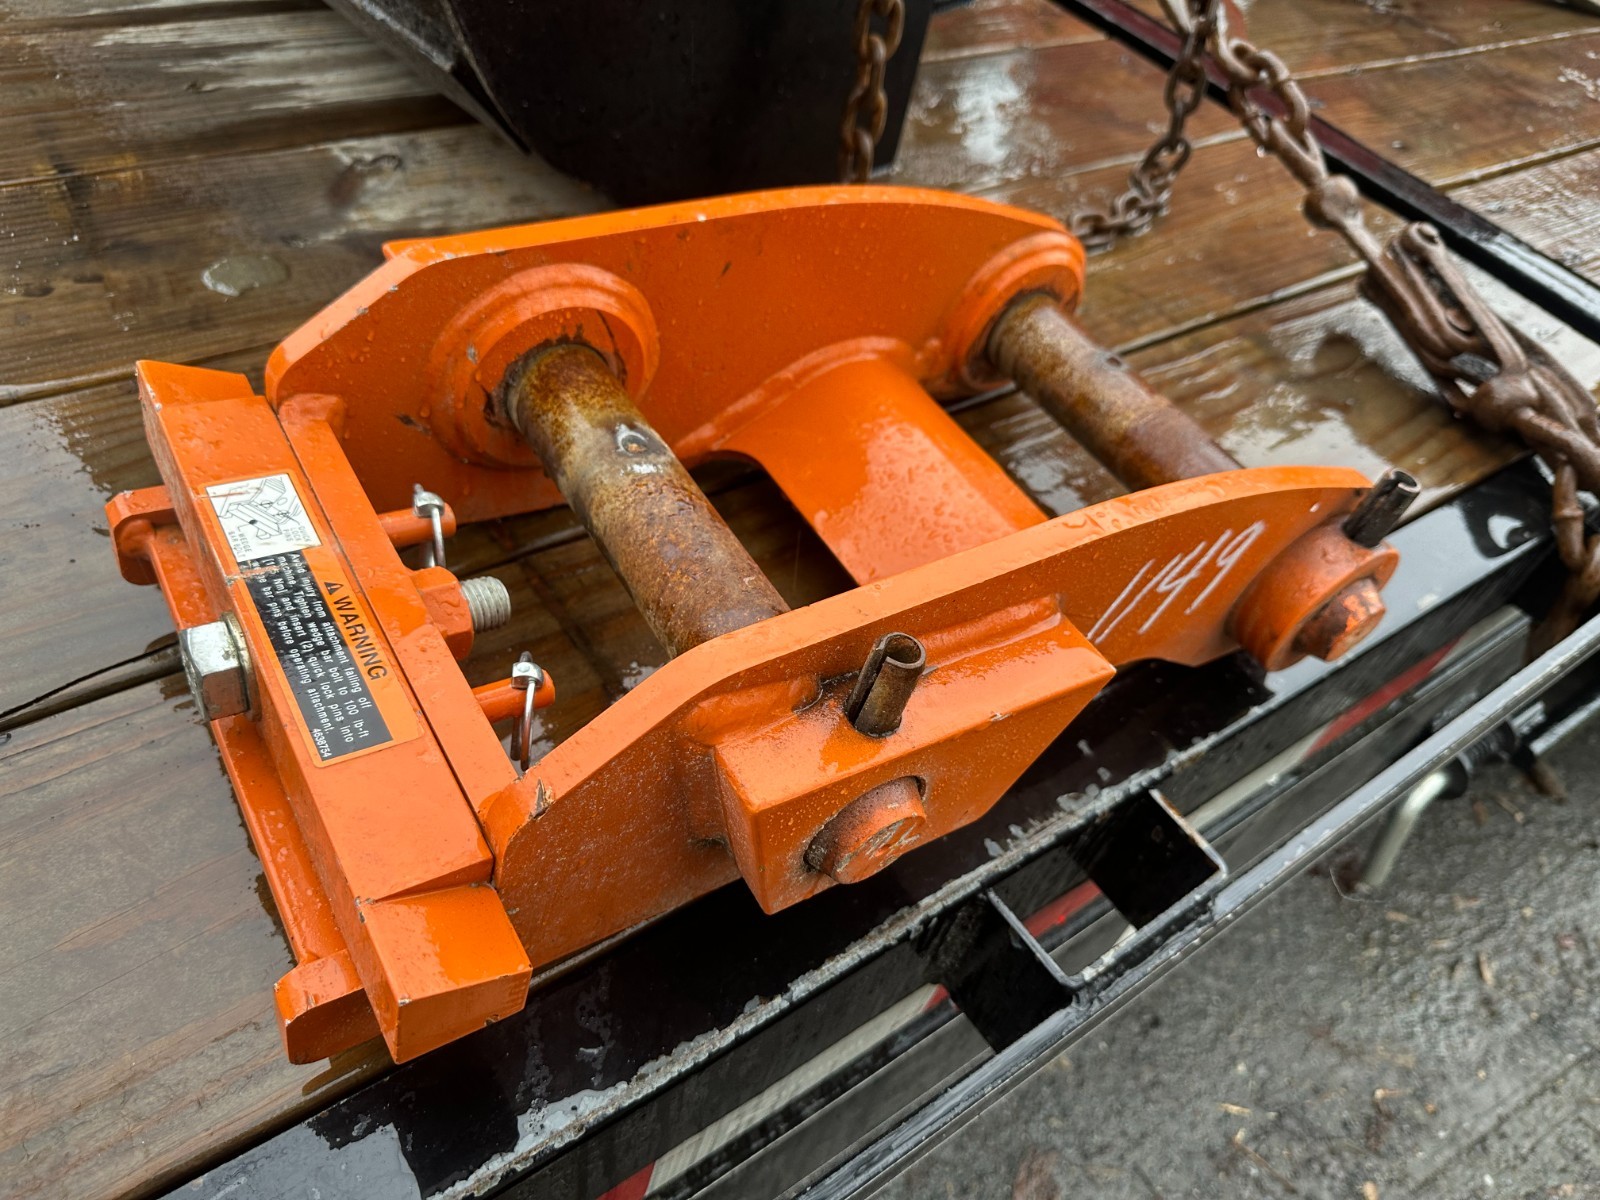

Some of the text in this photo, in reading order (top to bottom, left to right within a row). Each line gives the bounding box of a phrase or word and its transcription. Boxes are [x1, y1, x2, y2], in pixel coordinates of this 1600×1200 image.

[237, 532, 252, 552] WEDGE
[261, 585, 275, 599] bar
[266, 601, 284, 618] pins
[275, 619, 296, 645] before
[276, 555, 370, 738] machine. Tighten wedge bar bolt to 100 lb-ft
[288, 551, 372, 709] Avoid injury from attachment falling off
[331, 595, 390, 680] WARNING
[261, 557, 356, 743] [15 Nm] and insert (2) quick lock pins into
[285, 647, 314, 686] operating
[306, 686, 335, 734] attachment.
[310, 726, 332, 758] 4638754
